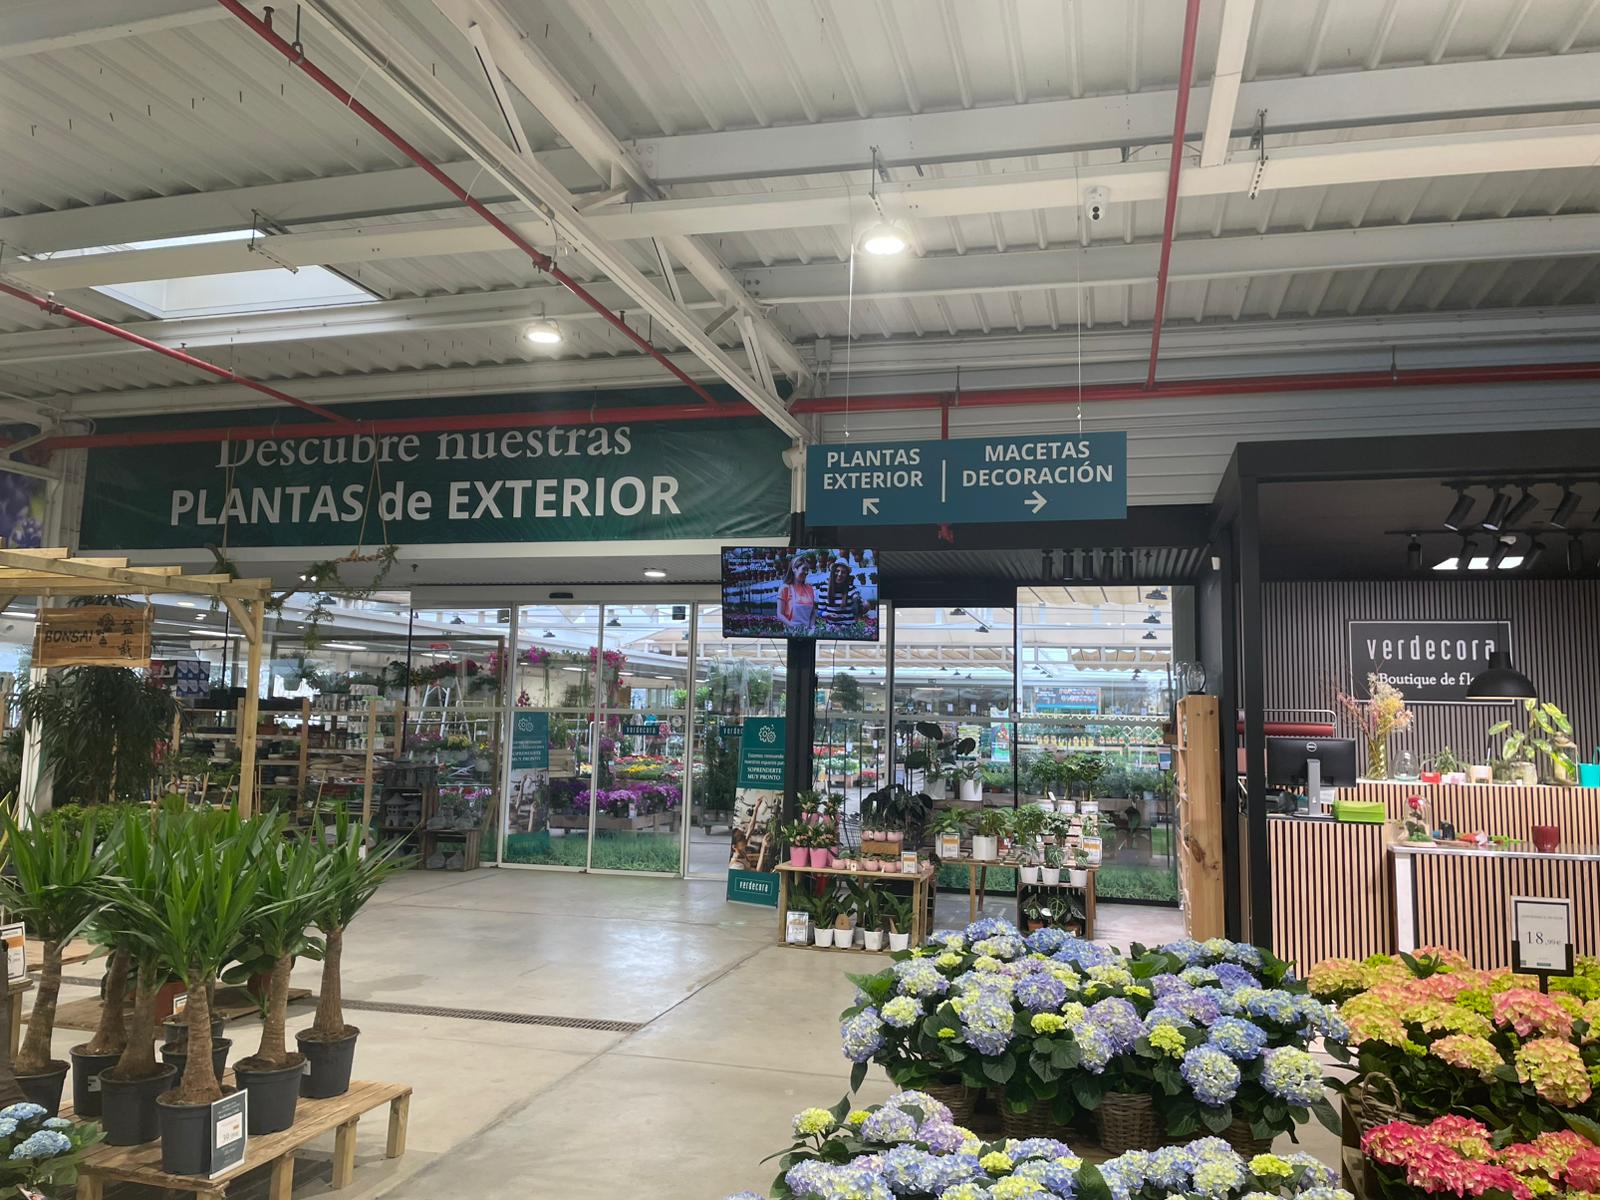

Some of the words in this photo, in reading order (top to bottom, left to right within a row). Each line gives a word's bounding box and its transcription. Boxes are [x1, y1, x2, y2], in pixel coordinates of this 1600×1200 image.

[214, 433, 420, 468] Descubre
[436, 426, 632, 460] nuestras
[985, 441, 1090, 462] MACETAS
[827, 448, 921, 468] PLANTAS
[823, 470, 924, 490] EXTERIOR
[962, 461, 1113, 487] DECORACIÓN
[170, 484, 365, 526] PLANTAS
[377, 481, 432, 521] de
[448, 475, 682, 520] EXTERIOR
[44, 629, 93, 643] BONSAI
[1367, 635, 1495, 661] verdecora
[1378, 672, 1437, 689] Boutique
[1440, 672, 1456, 685] de
[1459, 672, 1475, 685] fl
[740, 881, 768, 892] verdecora
